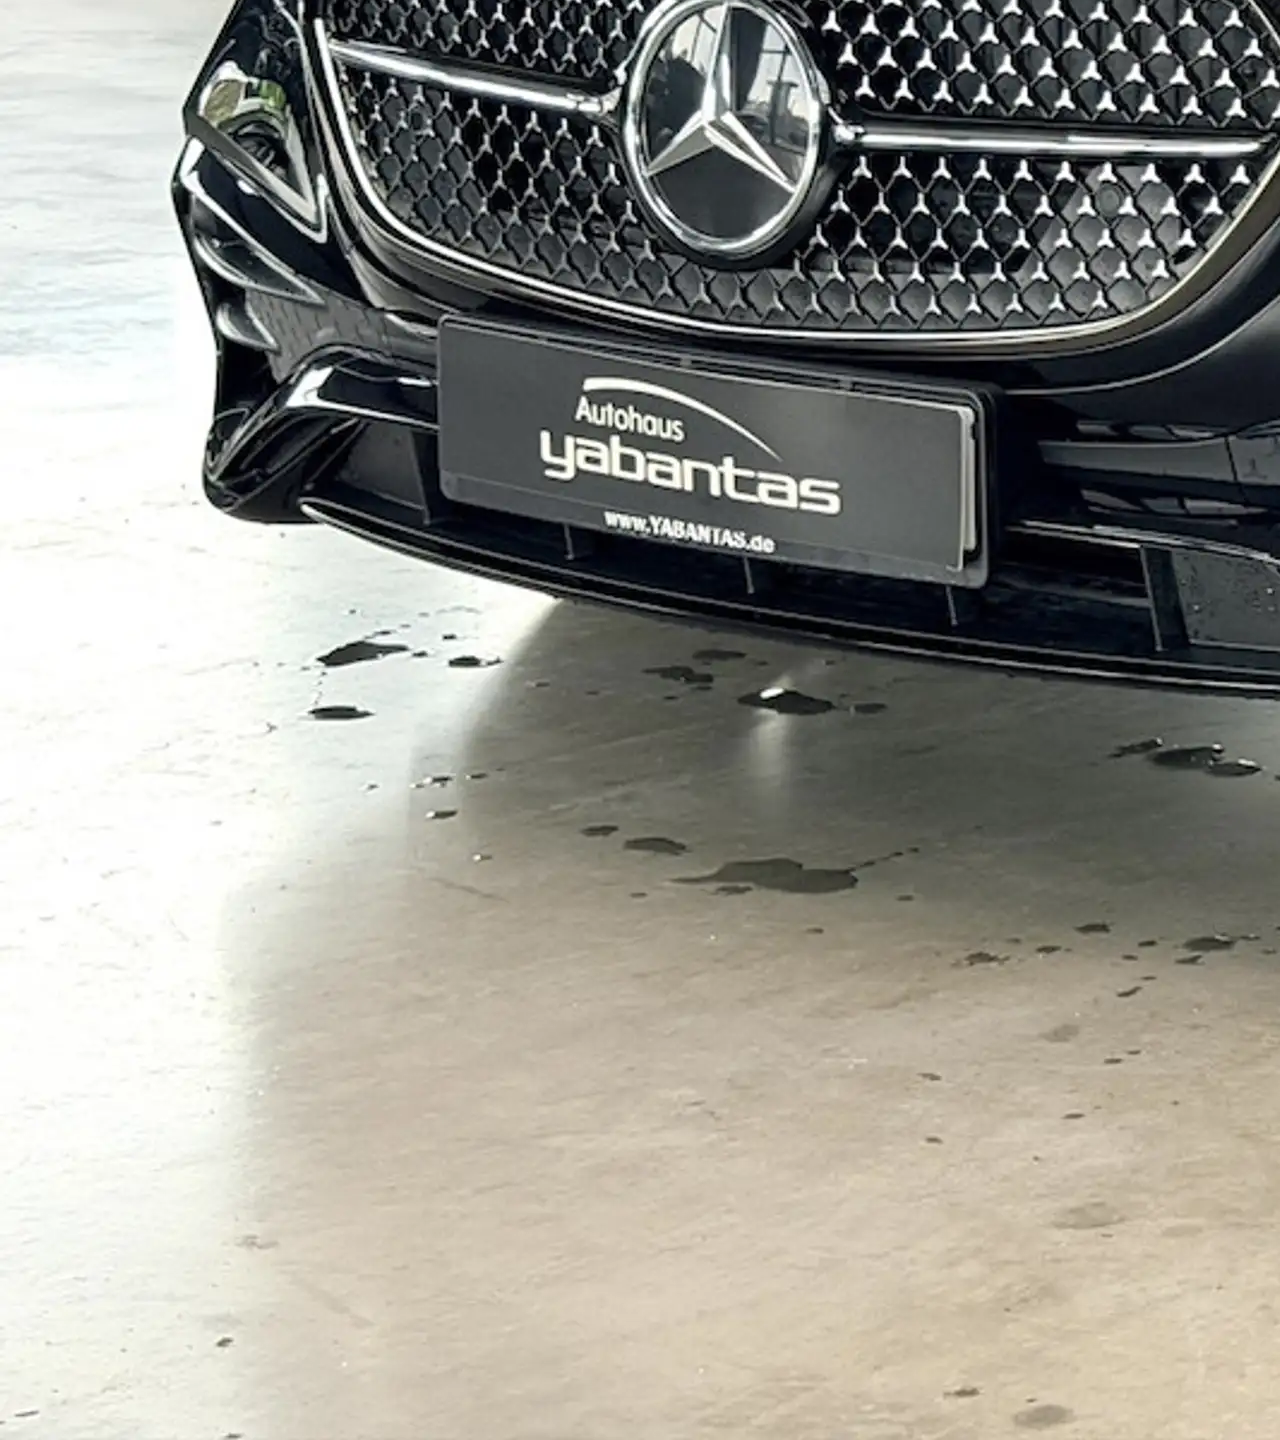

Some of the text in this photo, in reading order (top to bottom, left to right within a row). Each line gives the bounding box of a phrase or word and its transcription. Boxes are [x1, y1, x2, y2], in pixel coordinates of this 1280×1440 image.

[574, 394, 685, 443] Autohaus
[538, 429, 842, 516] yabantas
[603, 509, 776, 556] www.YABANTAS.de
